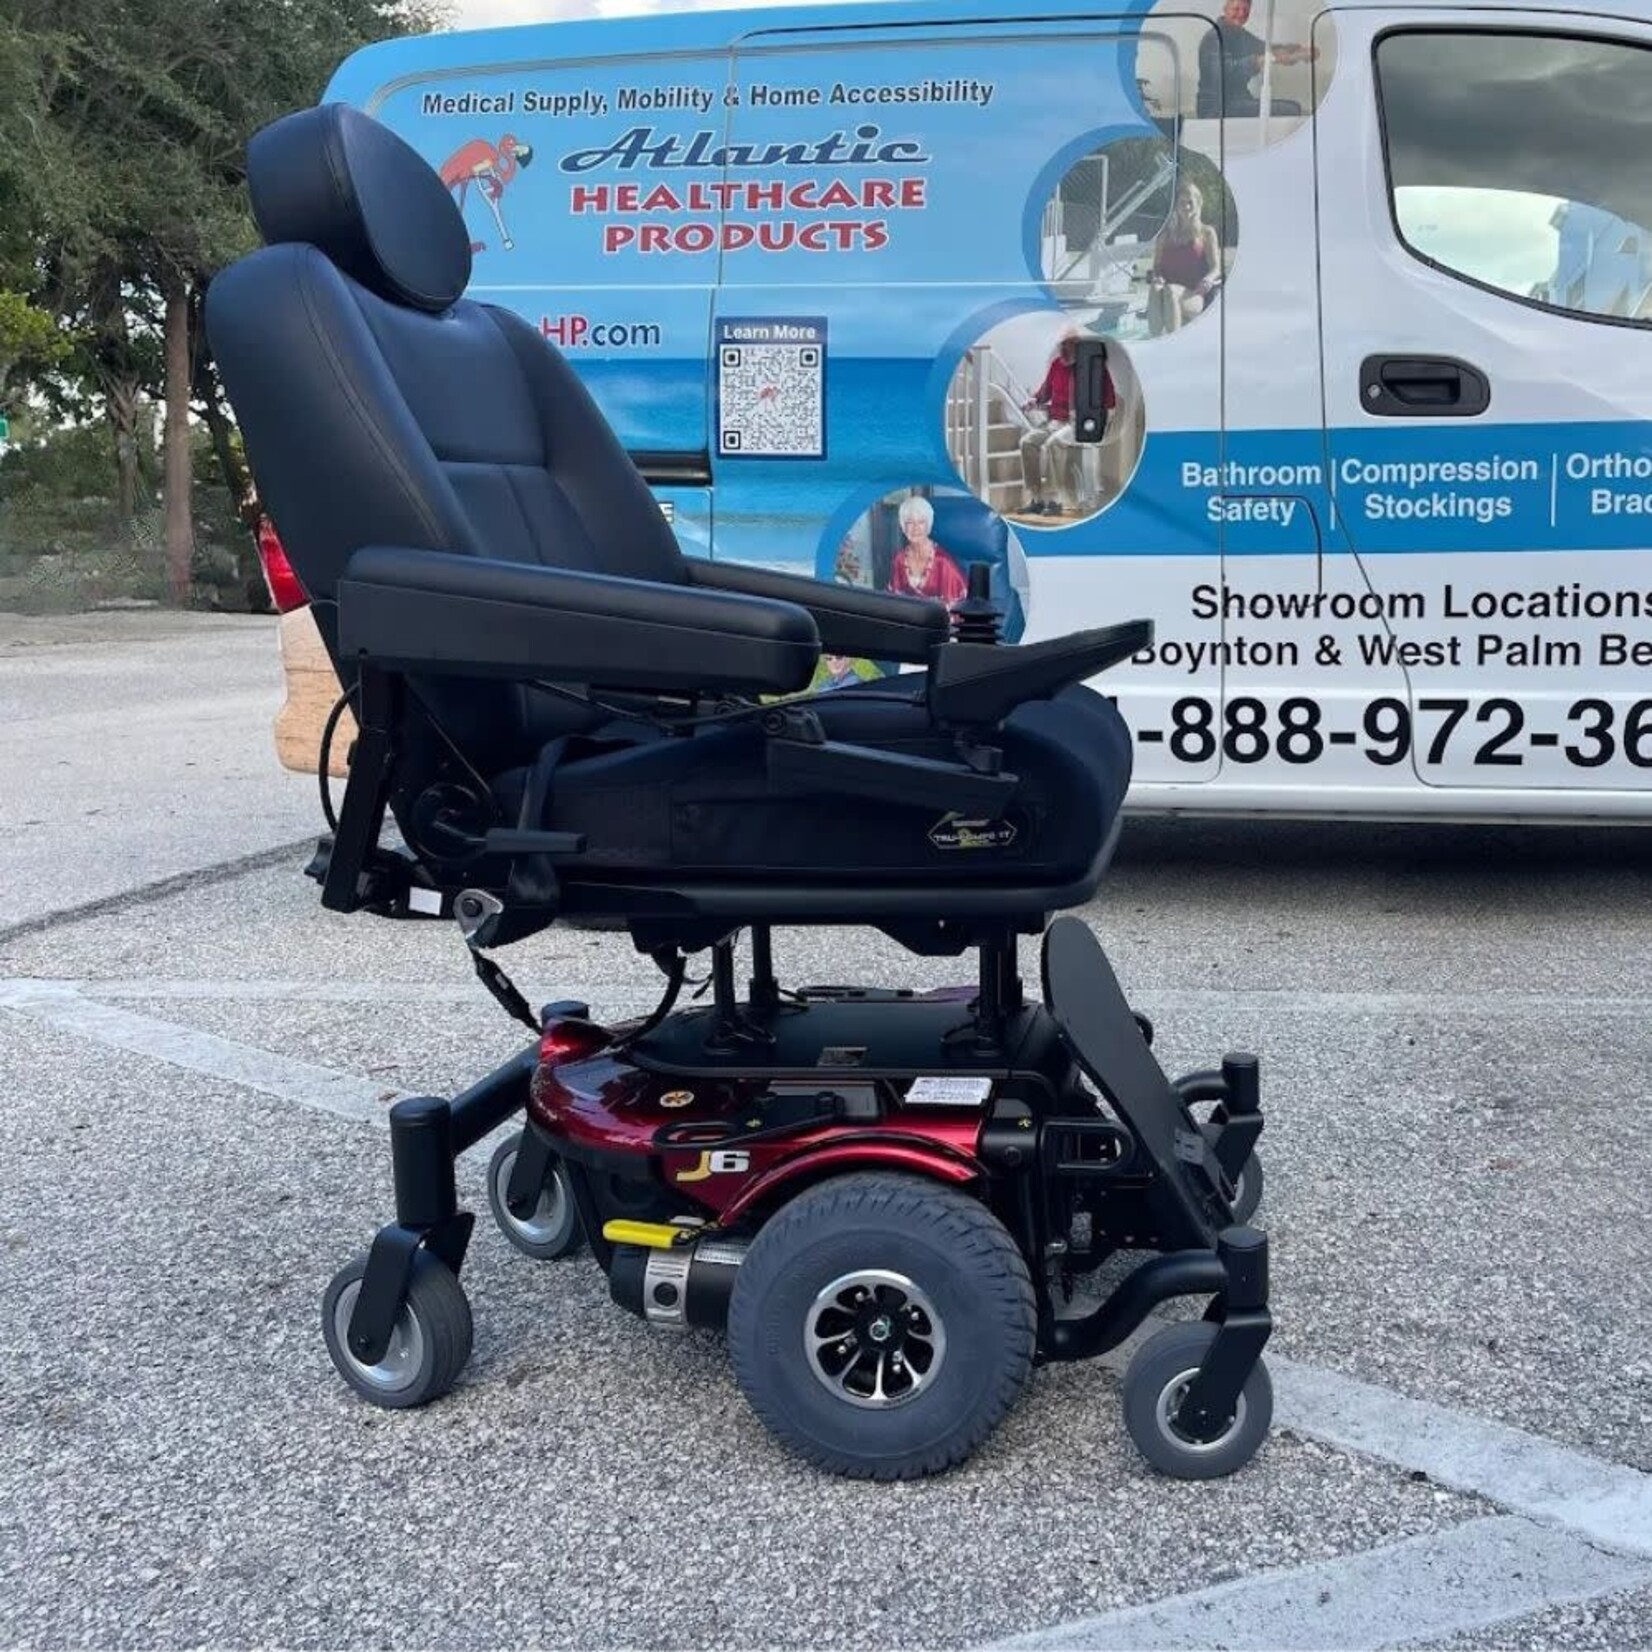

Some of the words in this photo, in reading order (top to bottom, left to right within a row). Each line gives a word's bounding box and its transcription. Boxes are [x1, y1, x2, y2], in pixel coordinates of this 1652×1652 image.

[423, 93, 514, 114] Medical
[523, 89, 608, 116] Supply,
[617, 87, 713, 113] Mobility
[722, 85, 739, 106] &
[750, 85, 821, 106] Home
[829, 80, 994, 106] Accessibility
[559, 125, 930, 173] Atlantic
[571, 179, 926, 213] HEALTHCARE
[604, 221, 889, 252] PRODUCTS
[724, 325, 769, 339] Learn
[774, 325, 816, 339] More
[1182, 462, 1321, 487] Bathroom
[1341, 455, 1538, 489] Compression
[1566, 452, 1652, 479] Ortho
[1207, 497, 1295, 526] Safety
[1365, 493, 1512, 523] Stockings
[1191, 585, 1425, 620] Showroom
[1314, 635, 1342, 666] &
[1358, 633, 1461, 667] West
[1477, 634, 1582, 667] Palm
[1600, 634, 1652, 667] Be
[1108, 696, 1652, 768] -888-972-36
[676, 1150, 750, 1182] J6
